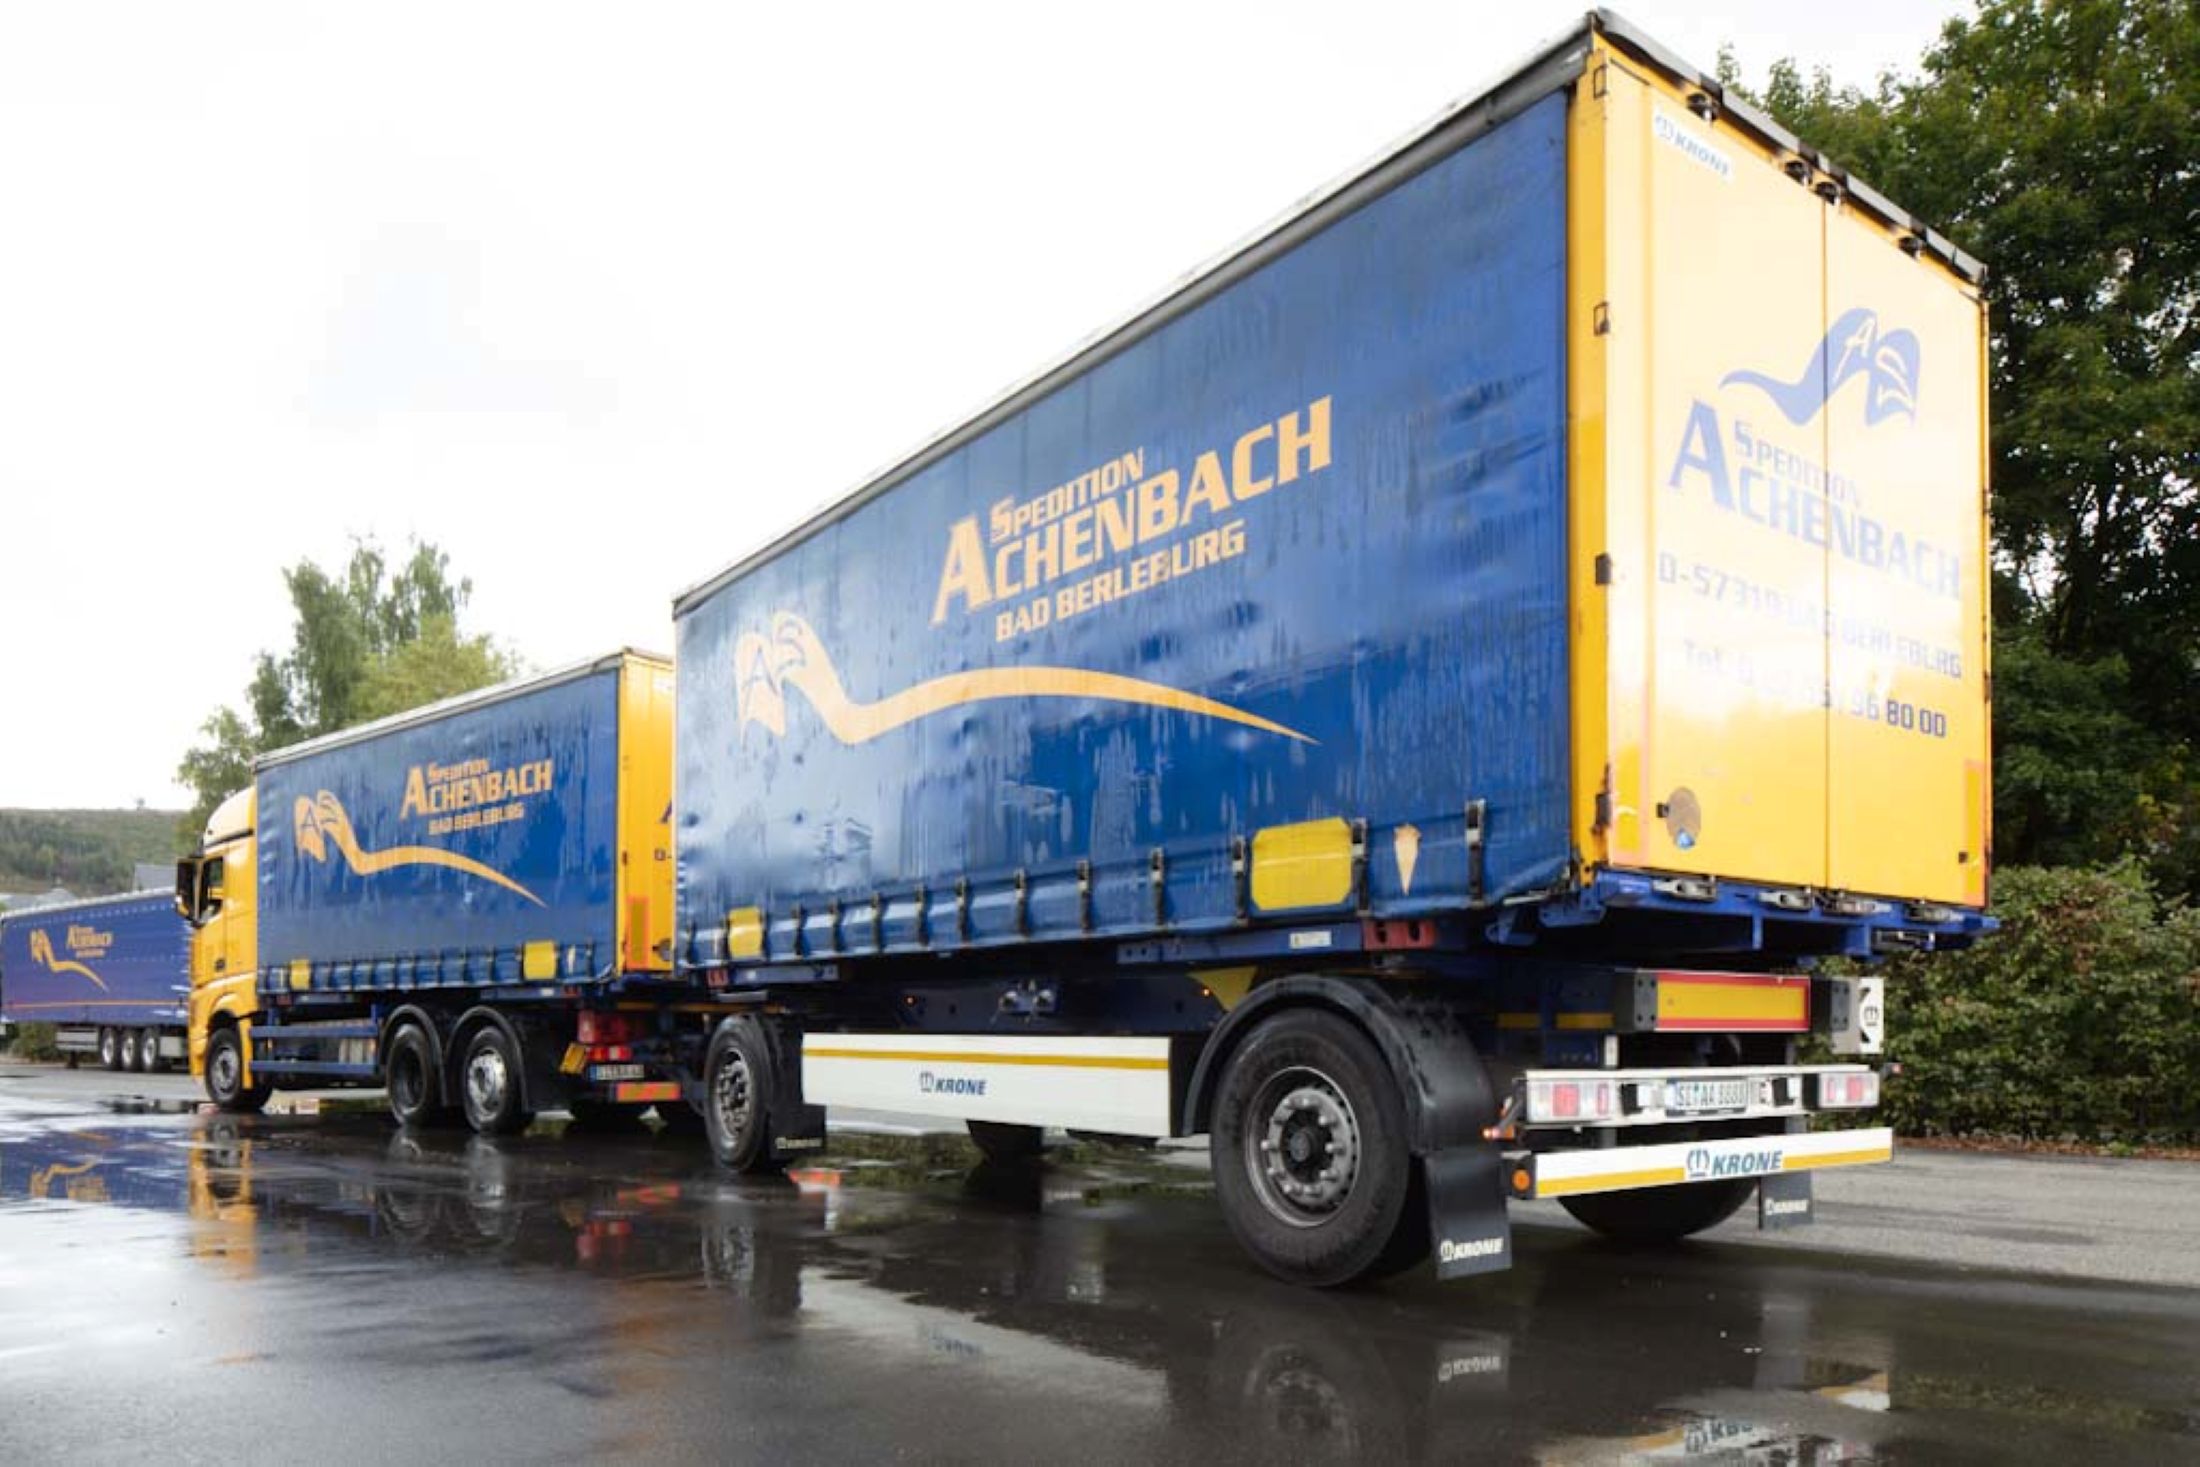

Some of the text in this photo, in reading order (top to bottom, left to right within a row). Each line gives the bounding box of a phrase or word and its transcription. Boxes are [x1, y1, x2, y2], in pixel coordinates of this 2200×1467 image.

[928, 394, 1333, 628] ACHENBACH
[989, 446, 1144, 544] SPEDITION
[1669, 398, 1961, 601] ACHENBACH
[996, 518, 1246, 642] BAD BERLEBURG
[1886, 698, 1914, 730] 80
[1918, 707, 1947, 739] 00
[400, 757, 554, 819] ACHENBACH
[936, 1077, 988, 1096] KRONE
[1711, 1149, 1783, 1176] KRONE
